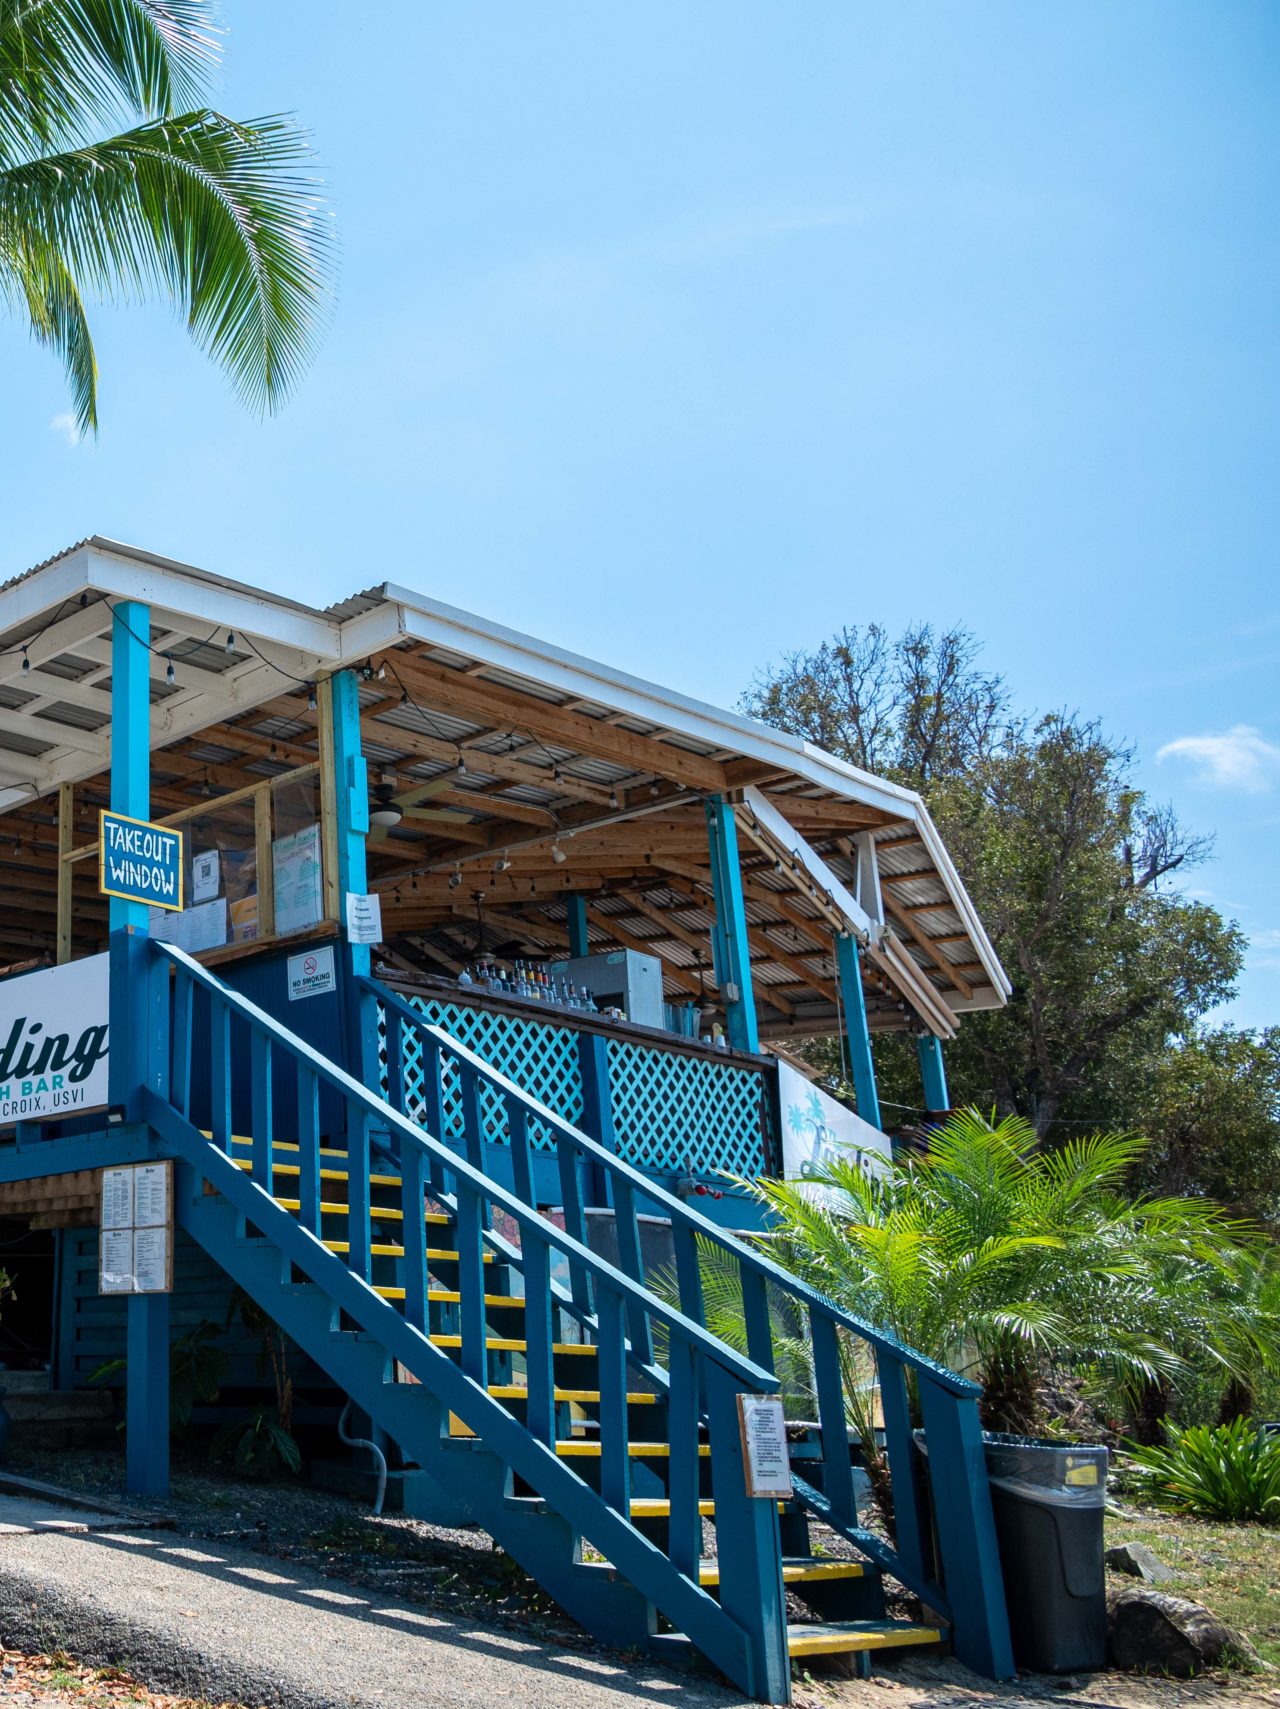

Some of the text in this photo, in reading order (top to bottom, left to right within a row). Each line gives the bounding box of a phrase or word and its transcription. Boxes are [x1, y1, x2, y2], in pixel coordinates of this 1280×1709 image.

[105, 822, 175, 865] TAKEOUT
[109, 856, 174, 896] WINDOW
[292, 980, 301, 988] NO
[303, 972, 331, 985] SMOKING
[22, 1074, 64, 1097] BAR
[3, 1096, 46, 1117] CROIX,
[54, 1088, 84, 1107] USVI
